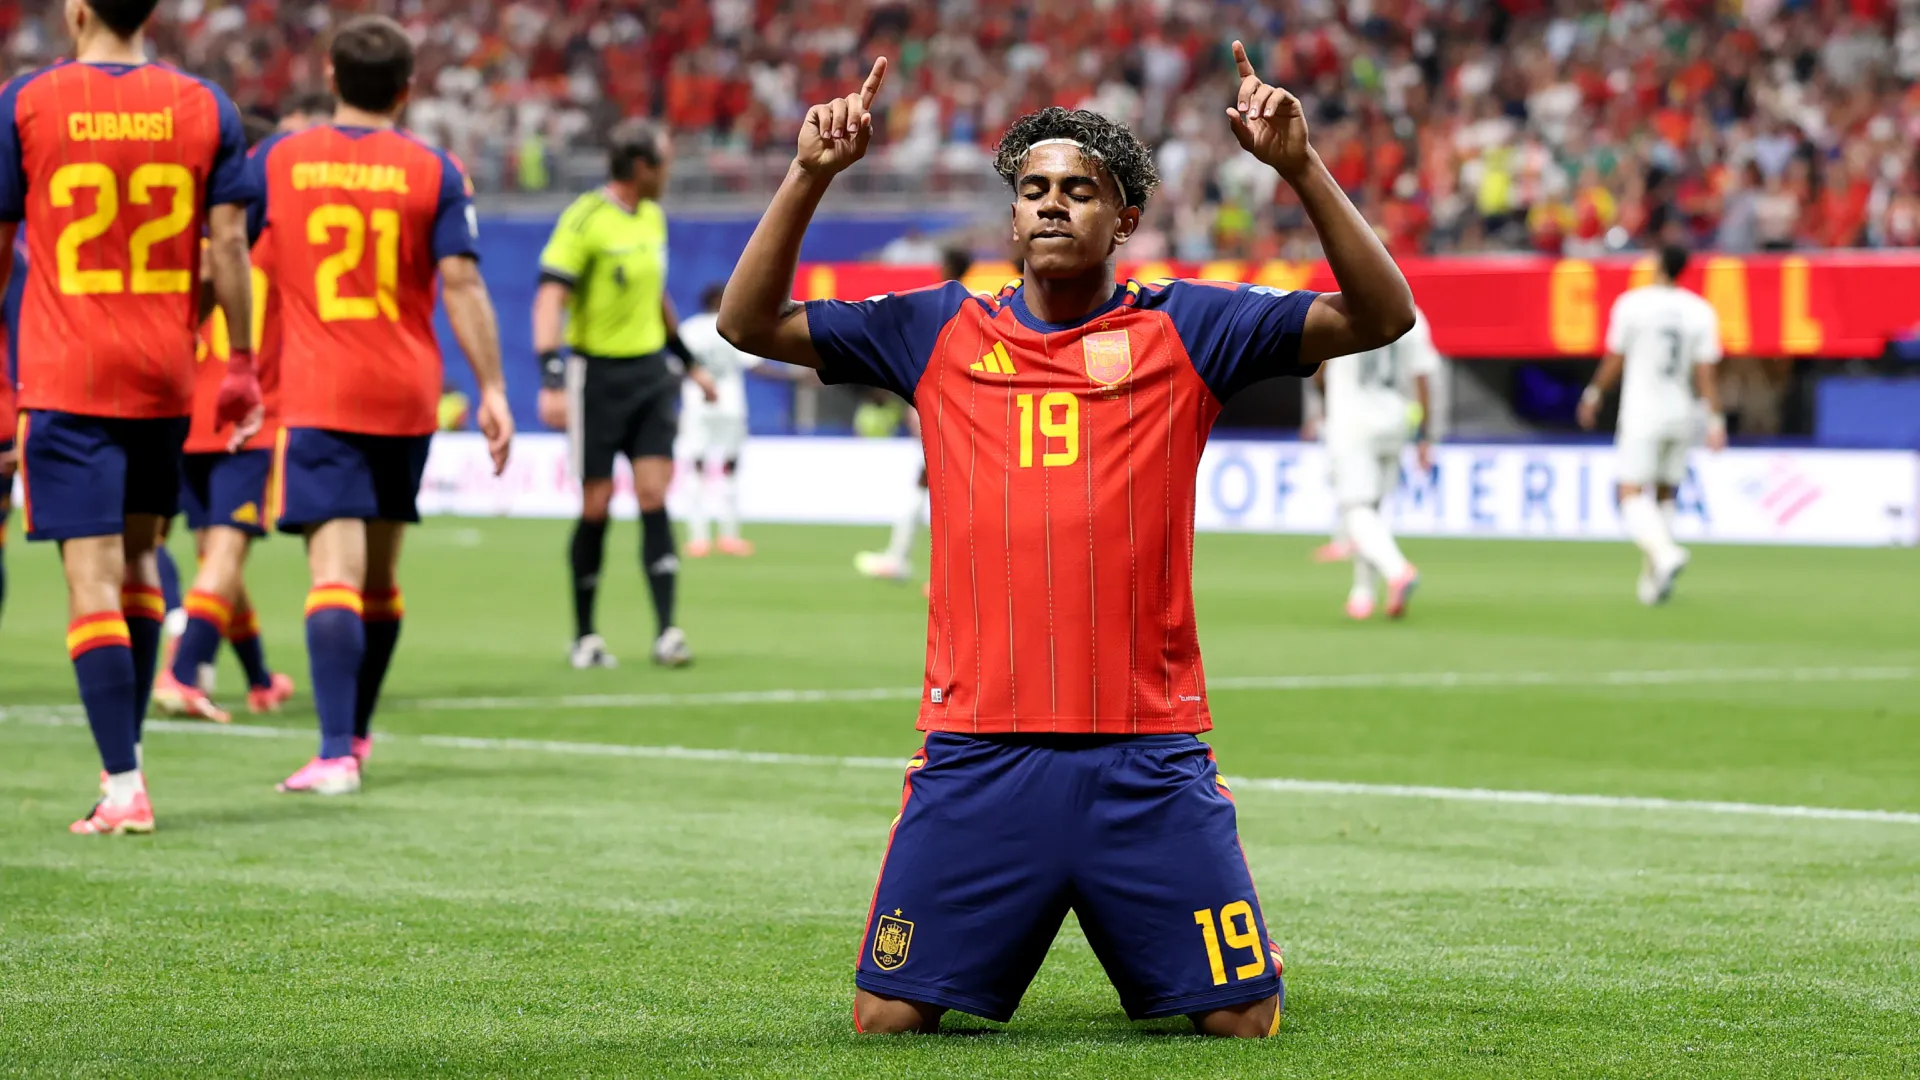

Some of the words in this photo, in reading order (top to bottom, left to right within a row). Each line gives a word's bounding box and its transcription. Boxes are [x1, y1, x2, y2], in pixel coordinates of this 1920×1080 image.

[68, 106, 173, 141] CUBARSÍ
[50, 162, 195, 295] 22
[307, 203, 400, 322] 21
[1552, 255, 1824, 354] GAL
[1016, 391, 1080, 468] 19
[1210, 456, 1298, 517] OF
[1395, 457, 1711, 522] MERIA
[1193, 899, 1267, 986] 19
